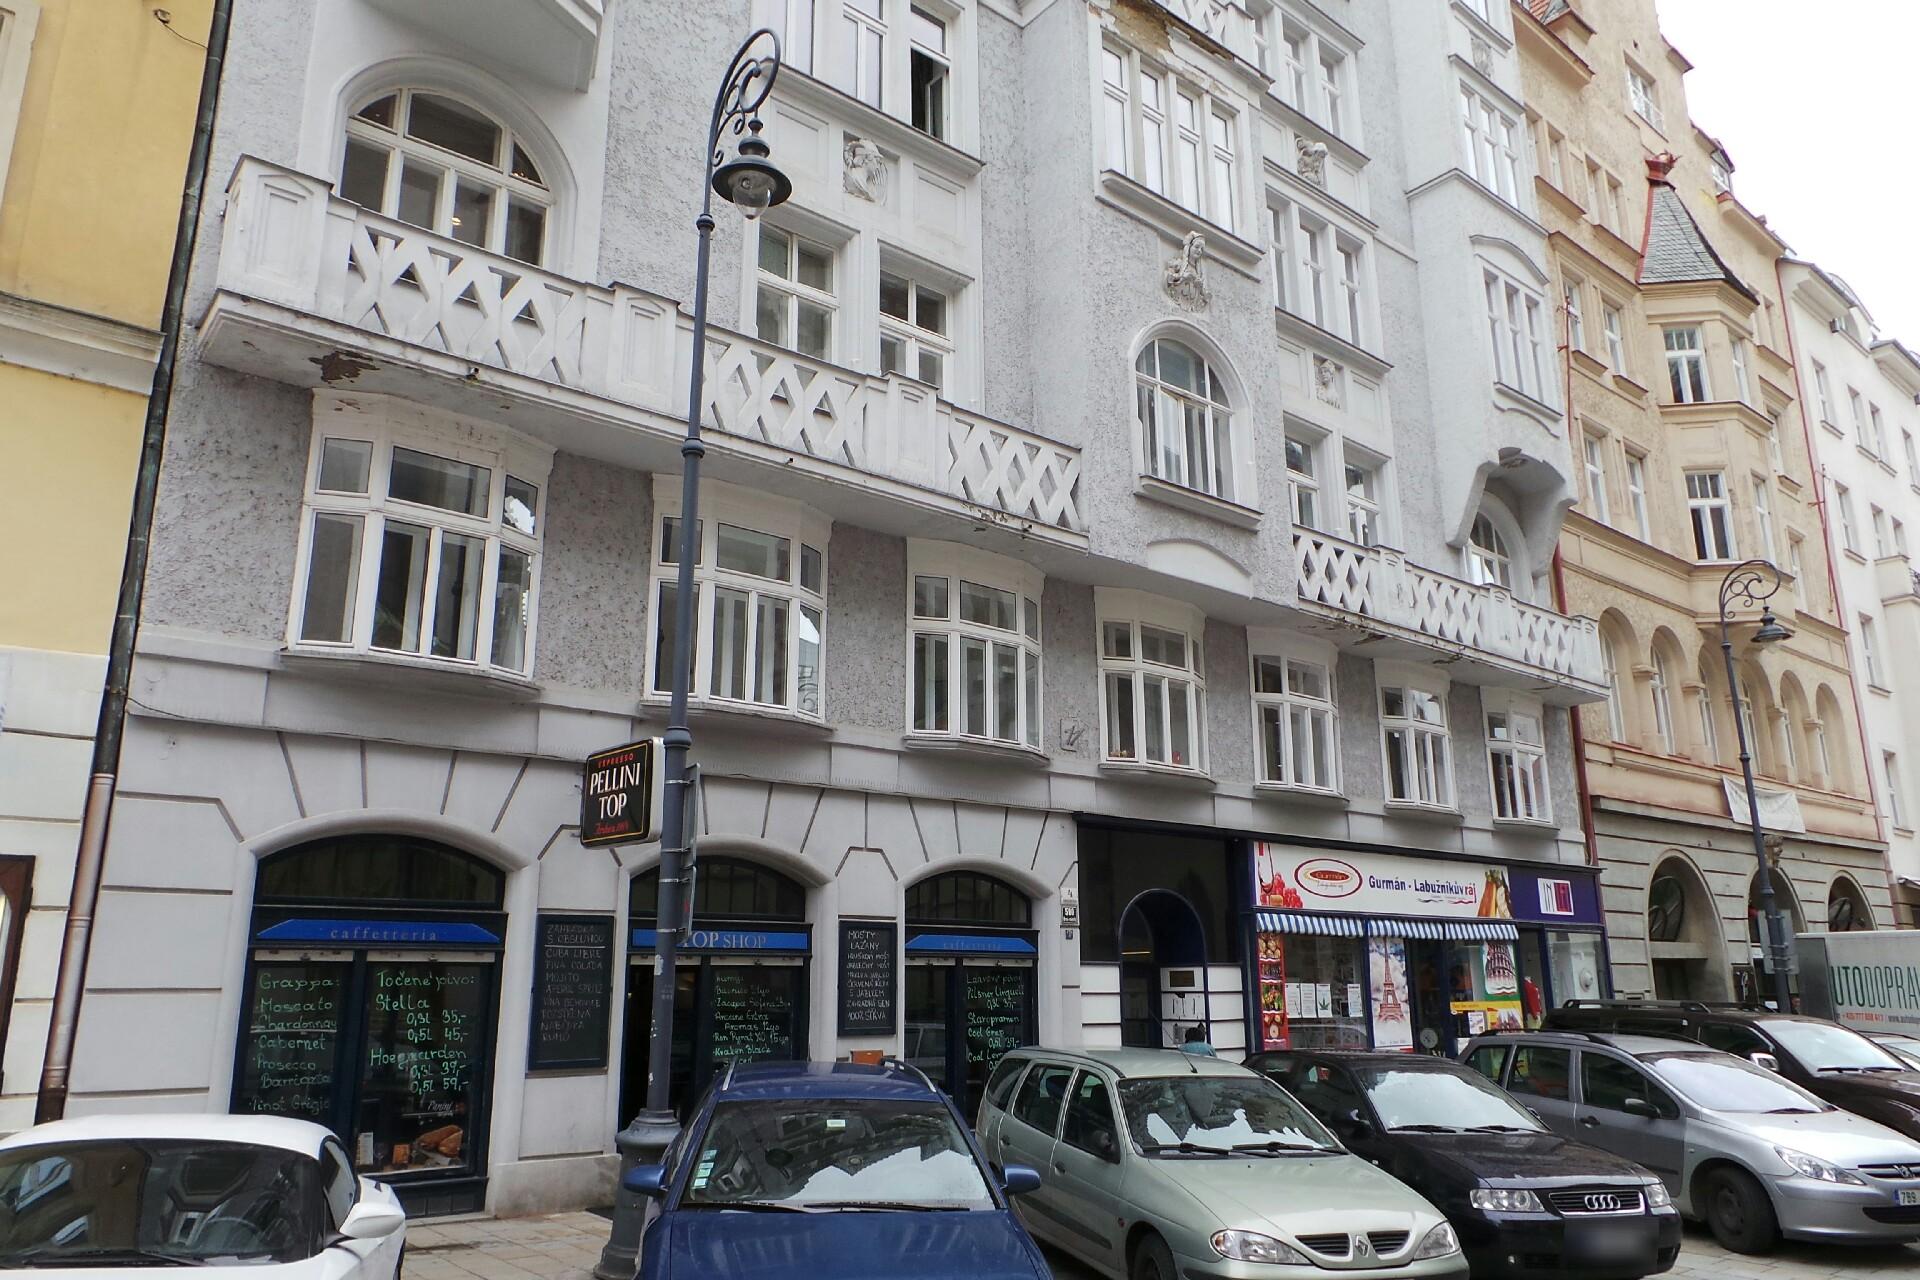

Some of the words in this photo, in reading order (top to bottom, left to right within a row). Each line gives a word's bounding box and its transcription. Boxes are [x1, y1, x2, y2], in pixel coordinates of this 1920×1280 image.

[590, 762, 641, 795] PELLINI
[599, 792, 628, 819] TOP
[1368, 875, 1406, 891] Gurmán
[1465, 883, 1477, 903] ráj
[330, 926, 437, 940] caffetteria
[683, 930, 719, 948] OP
[722, 934, 767, 949] SHOP
[377, 969, 433, 988] Točené
[261, 996, 333, 1013] Moscato
[376, 993, 430, 1011] Stella
[258, 1033, 327, 1050] Cabernet
[257, 1053, 316, 1071] Prosecco
